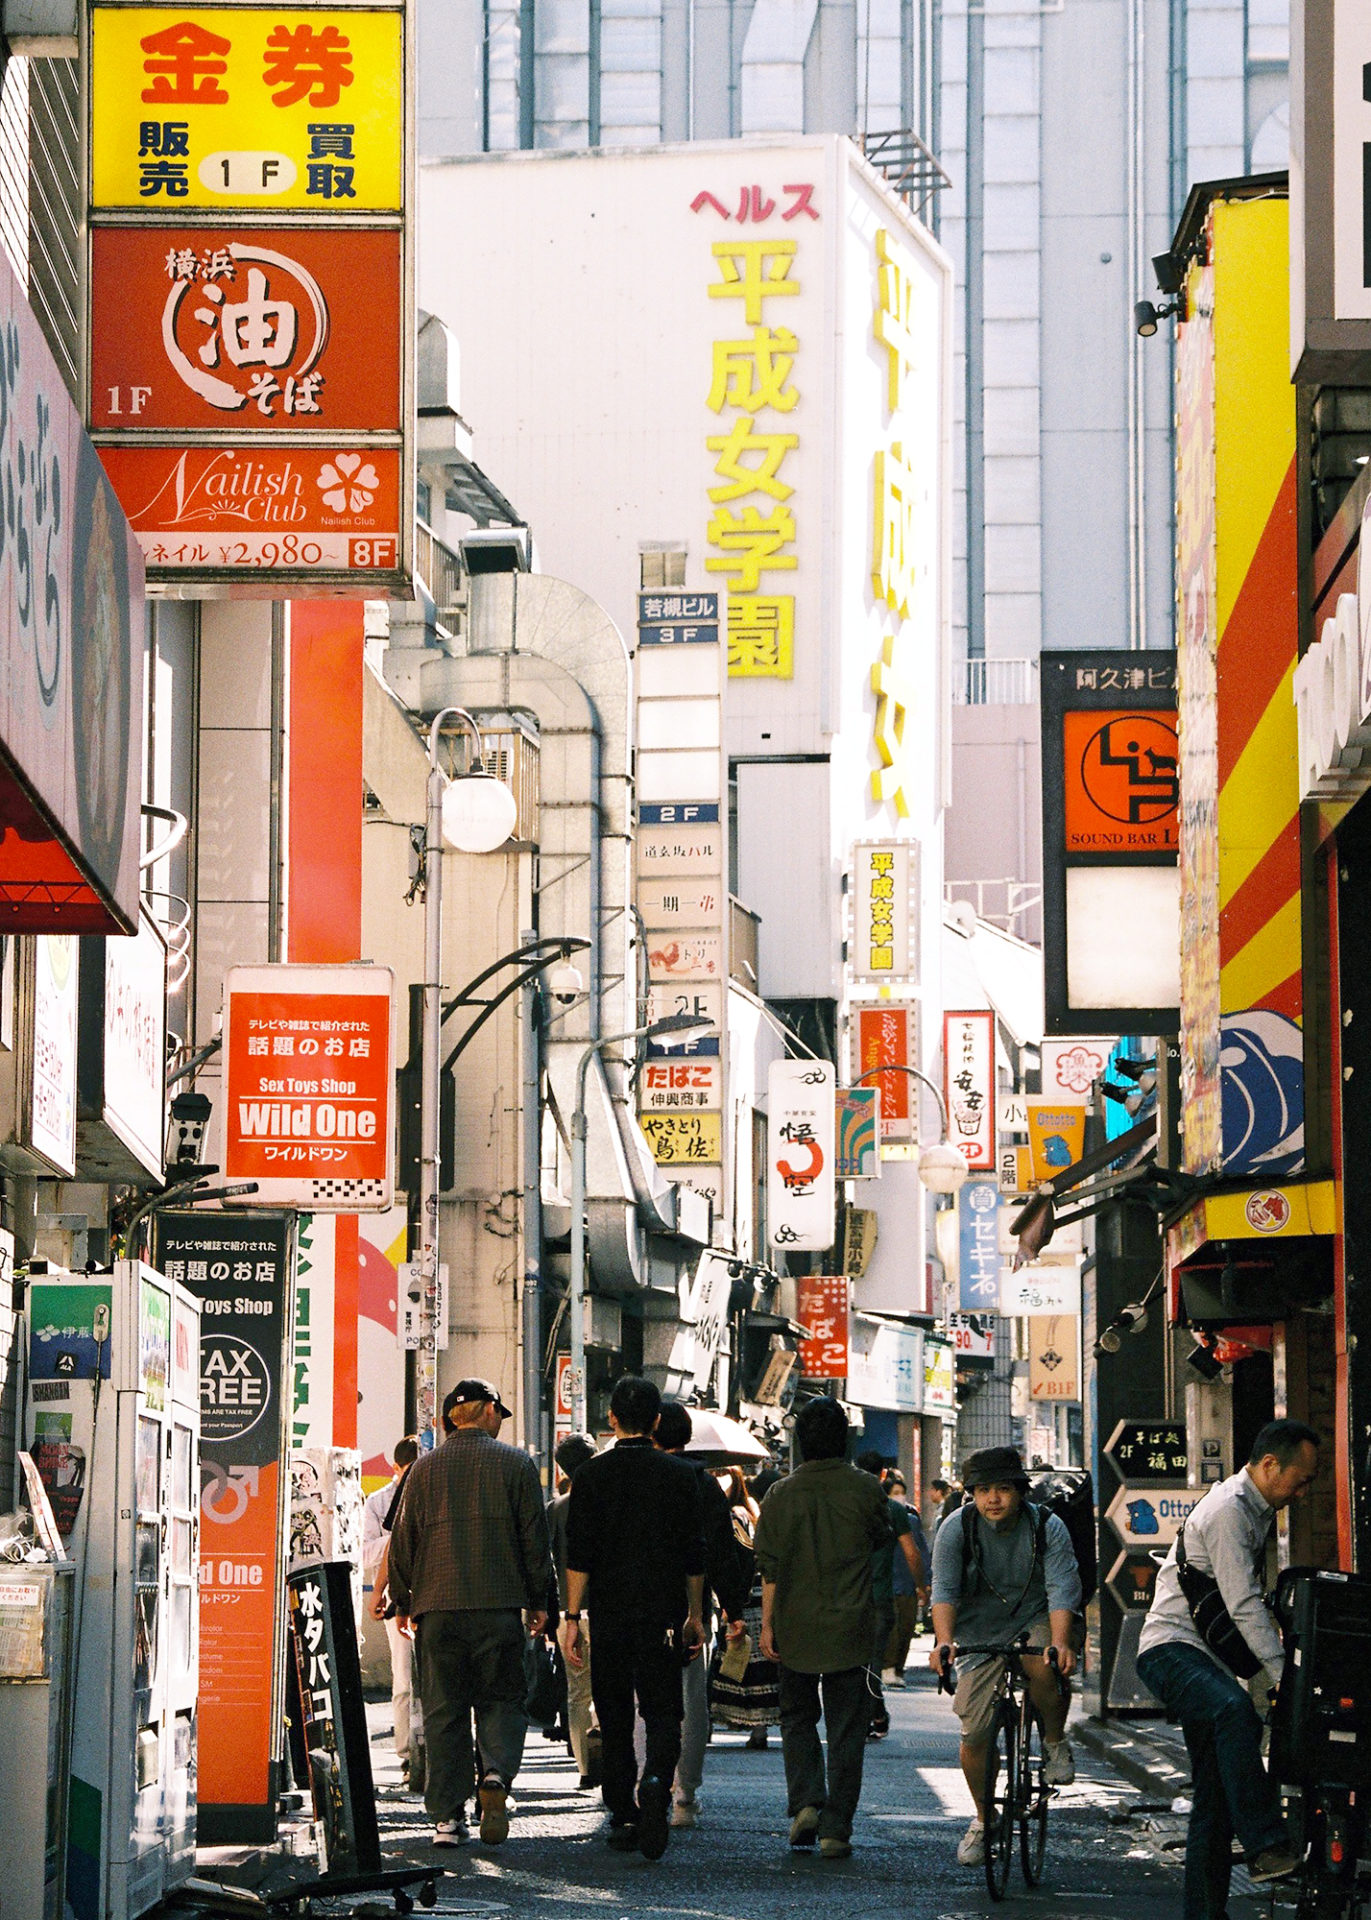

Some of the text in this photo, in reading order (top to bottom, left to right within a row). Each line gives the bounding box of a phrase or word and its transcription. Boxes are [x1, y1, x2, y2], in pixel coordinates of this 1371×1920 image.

[140, 20, 355, 109] 金券
[138, 121, 190, 197] 販売
[306, 123, 357, 199] 買取
[690, 182, 822, 224] ヘルス
[164, 247, 236, 282] 横浜
[194, 267, 299, 371] 油
[107, 385, 153, 416] 1F
[247, 371, 326, 417] そば
[706, 239, 801, 680] 平成女学園
[128, 449, 303, 525] Nailish
[243, 496, 307, 523] Club
[320, 516, 376, 526] Nailish Club
[353, 539, 390, 567] 8F
[1071, 833, 1124, 846] SOUND
[1127, 833, 1158, 847] BAR
[248, 1036, 370, 1057] 話題のお店
[259, 1077, 357, 1095] Sex Toys Shop
[646, 1065, 713, 1088] たばこ
[239, 1103, 377, 1138] Wild One
[644, 1118, 701, 1138] やきとり
[264, 1146, 348, 1161] ワイルドワン
[164, 1260, 276, 1282] 話題のお店
[234, 1297, 274, 1316] Shop
[61, 1326, 93, 1339] 伊藤
[800, 1291, 846, 1365] たばこ
[200, 1377, 262, 1405] REE
[1119, 1445, 1134, 1459] 2F
[218, 1560, 263, 1585] One
